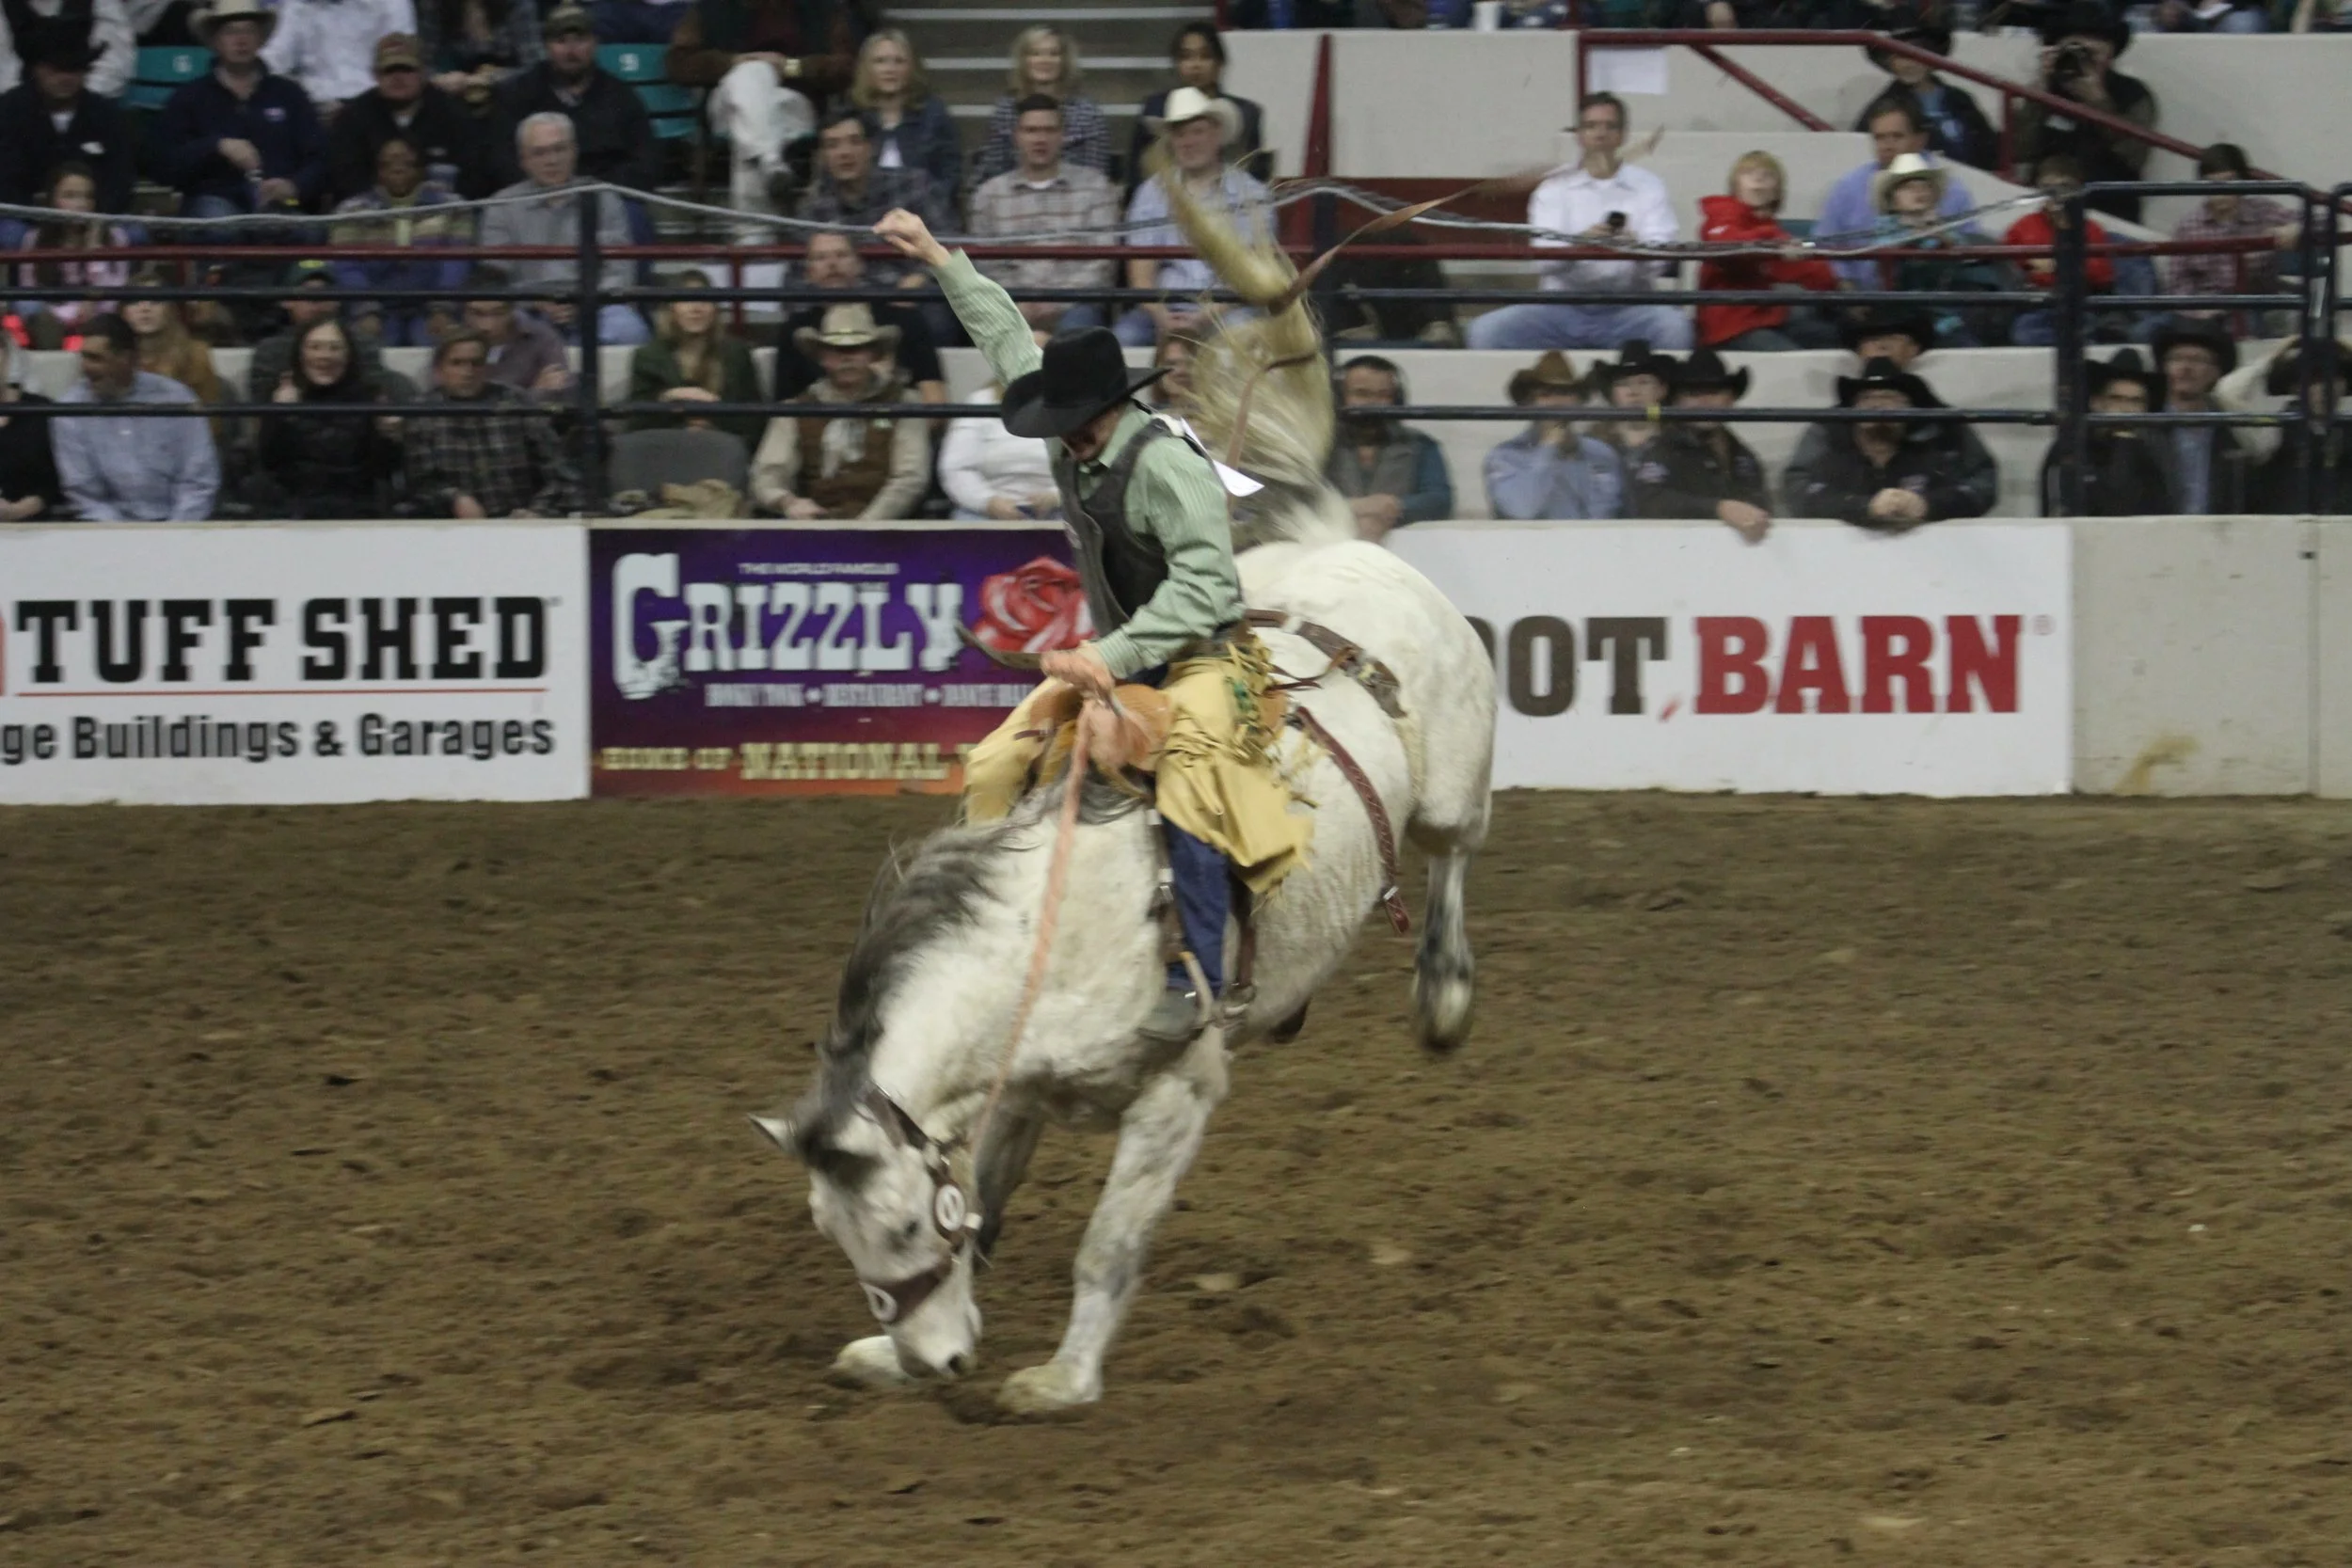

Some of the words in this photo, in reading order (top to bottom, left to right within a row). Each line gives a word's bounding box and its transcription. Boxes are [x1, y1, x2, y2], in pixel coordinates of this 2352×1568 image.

[15, 598, 278, 684] TUFF
[300, 595, 548, 681] SHED
[613, 553, 963, 699] GRIZZLY
[1692, 614, 2023, 715] BARN
[72, 715, 300, 763] Buildings
[313, 721, 345, 757] &
[359, 712, 556, 760] Garages
[740, 742, 947, 780] NATIONAL
